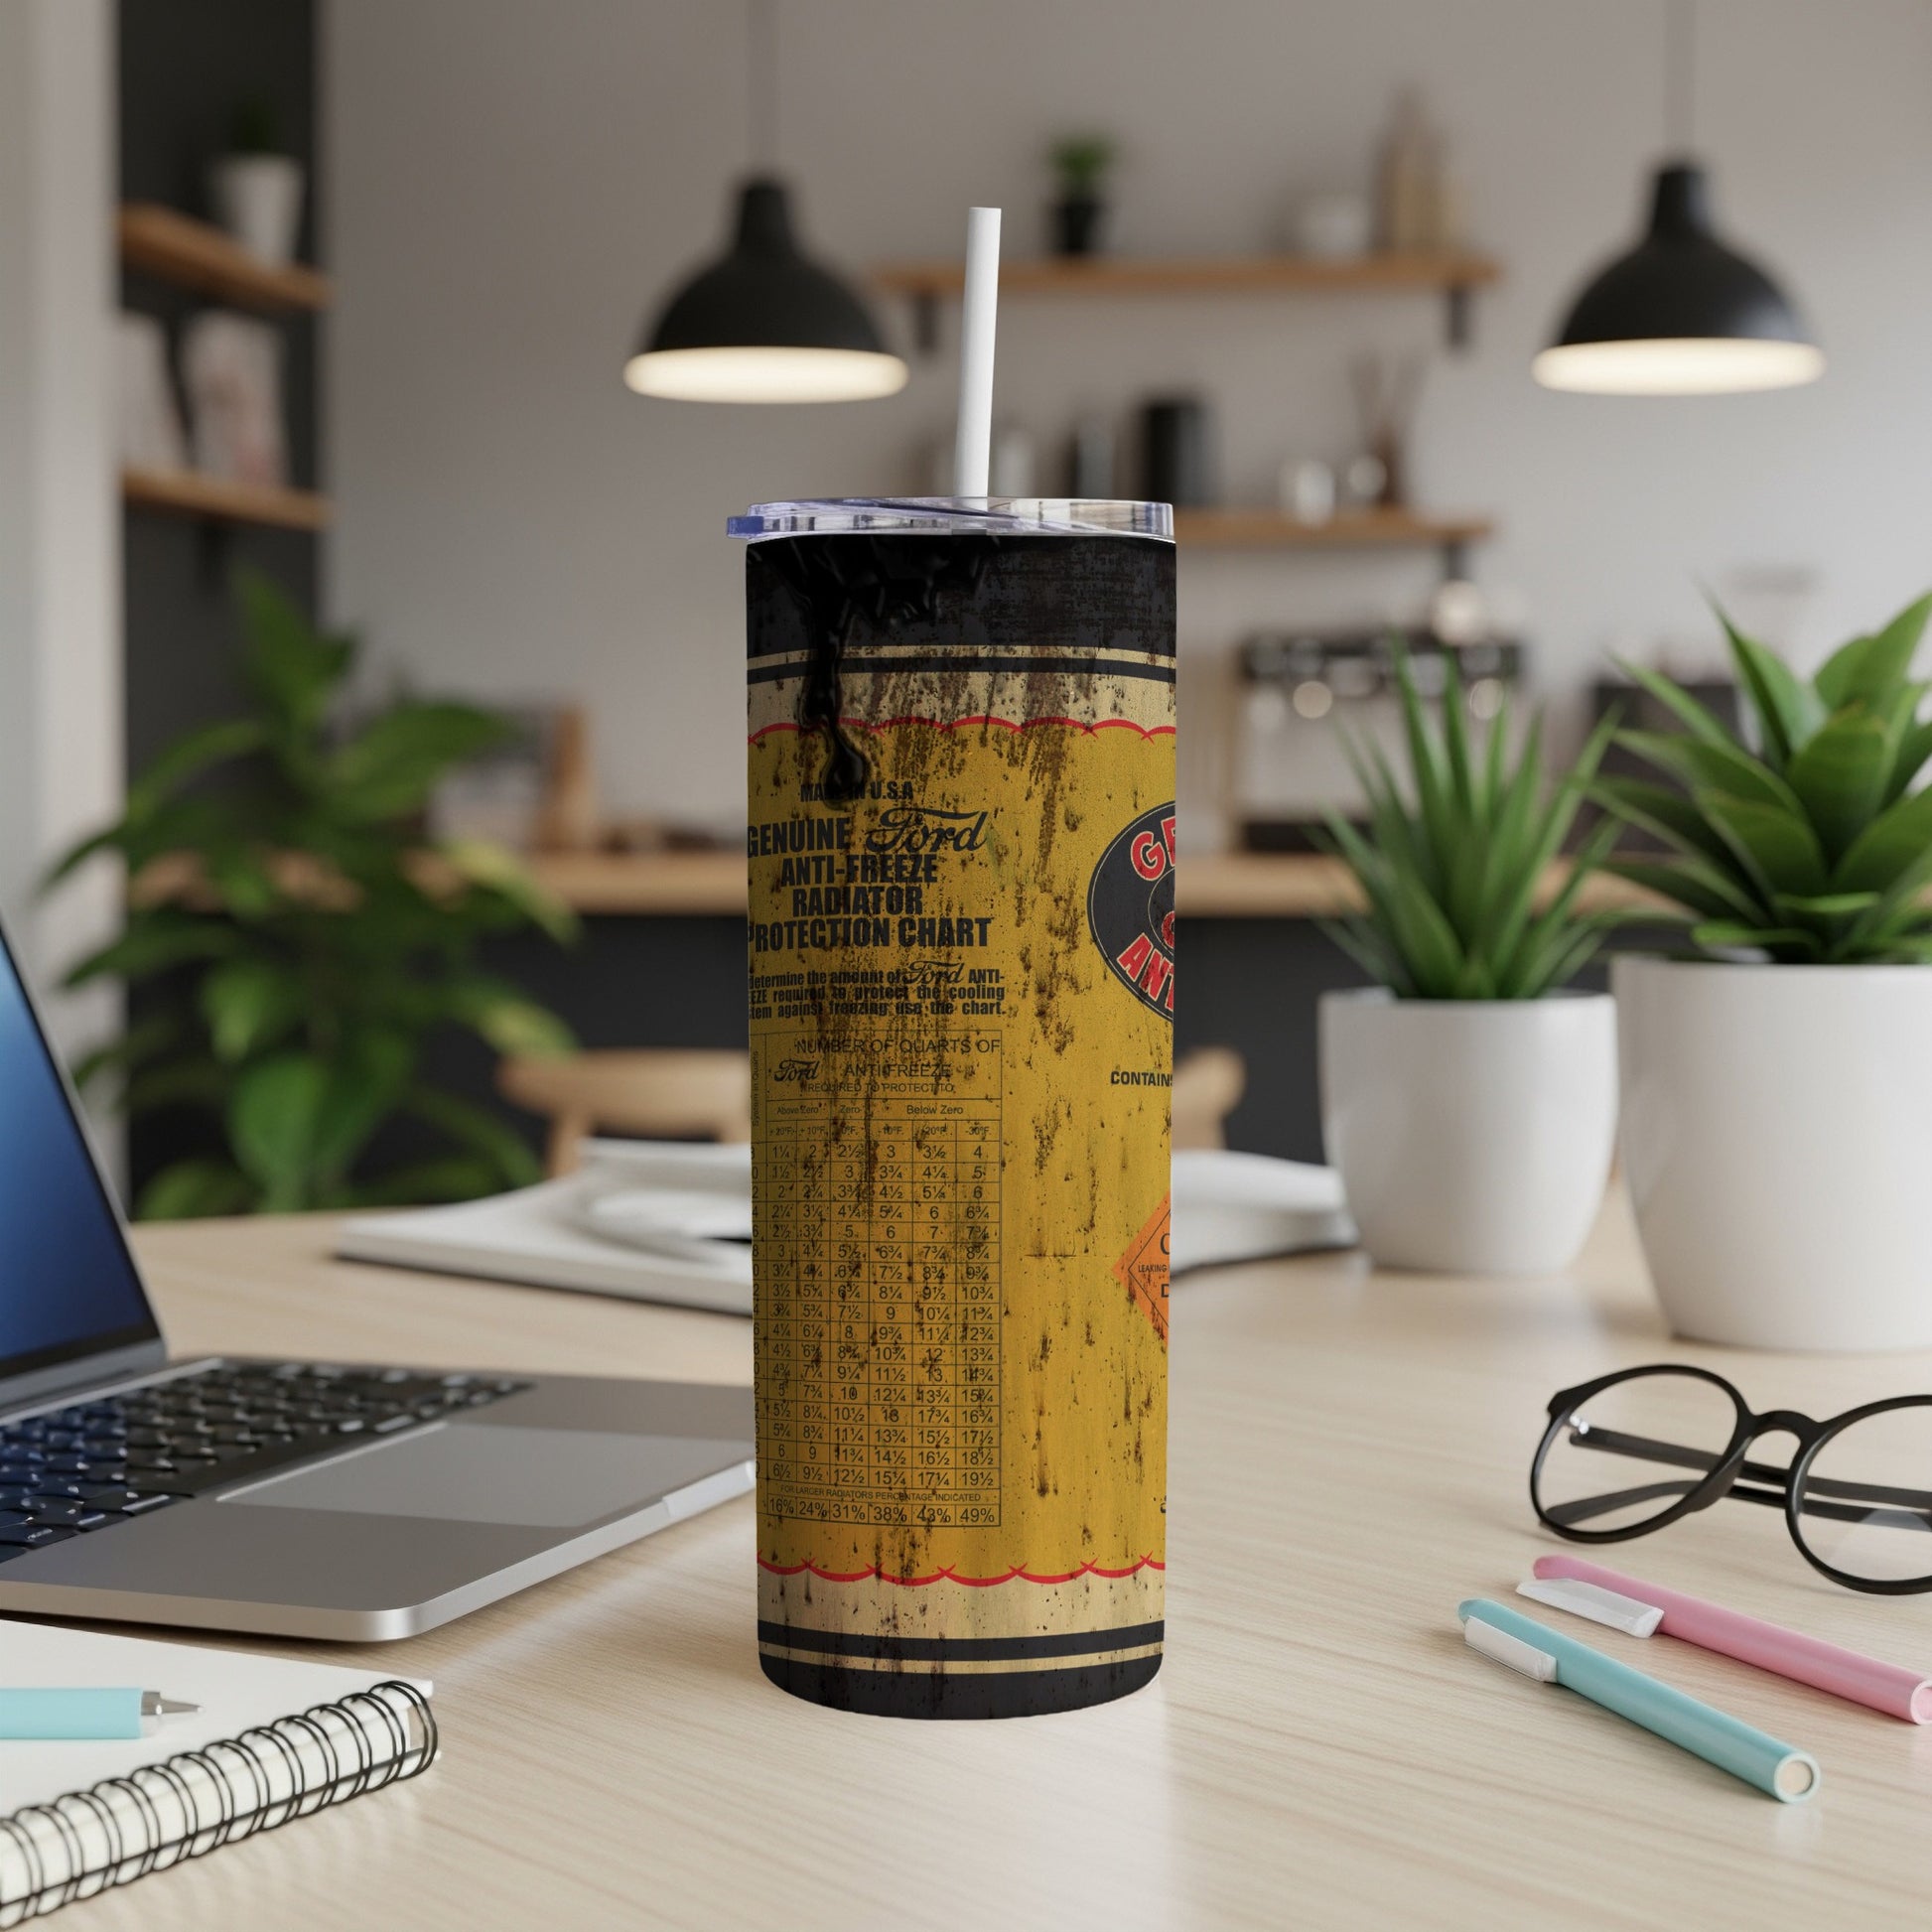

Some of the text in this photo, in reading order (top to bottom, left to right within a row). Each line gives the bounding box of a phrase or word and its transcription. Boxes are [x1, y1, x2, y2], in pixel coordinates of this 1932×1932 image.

[748, 807, 988, 858] GENUINE Ford
[781, 855, 937, 887] ANTI-FREEZE
[793, 887, 922, 917] RADIATOR
[898, 918, 991, 947] CHART
[807, 970, 826, 984] the
[830, 971, 884, 984] amount
[888, 969, 900, 983] of
[902, 960, 964, 985] Ford
[969, 969, 1004, 983] ANTI-
[773, 986, 825, 1002] required
[832, 987, 846, 999] to
[855, 985, 907, 1000] protect
[917, 985, 940, 999] the
[949, 985, 1005, 1000] cooling
[778, 1003, 822, 1018] against
[829, 1001, 888, 1016] freezing
[896, 1002, 922, 1015] use
[930, 1002, 953, 1014] the
[962, 1001, 1006, 1015] chart.
[797, 1039, 1000, 1053] NUMBER OF QUARTS OF
[773, 1059, 820, 1081] Ford
[808, 1083, 954, 1092] REQUIRED TO PROTECT TO
[907, 1105, 936, 1114] Below
[810, 1145, 816, 1158] 2
[887, 1146, 896, 1158] 3
[974, 1146, 982, 1158] 4
[846, 1166, 853, 1178] 3
[974, 1167, 982, 1178] 5
[778, 1185, 784, 1198] 2
[974, 1186, 982, 1198] 6
[930, 1206, 938, 1219] 6
[846, 1225, 853, 1237] 5
[887, 1225, 895, 1239] 6
[930, 1226, 938, 1239] 7
[778, 1245, 784, 1257] 3
[887, 1307, 896, 1319] 9
[845, 1325, 853, 1338] 8
[779, 1445, 784, 1457] 6
[809, 1446, 816, 1459] 9
[827, 1489, 874, 1499] RADIATORS
[936, 1493, 981, 1502] INDICATED
[770, 1498, 794, 1514] 16%
[799, 1501, 827, 1517] 24%
[833, 1504, 865, 1520] 31%
[874, 1506, 906, 1522] 38%
[917, 1508, 951, 1523] 43%
[960, 1508, 995, 1523] 49%
